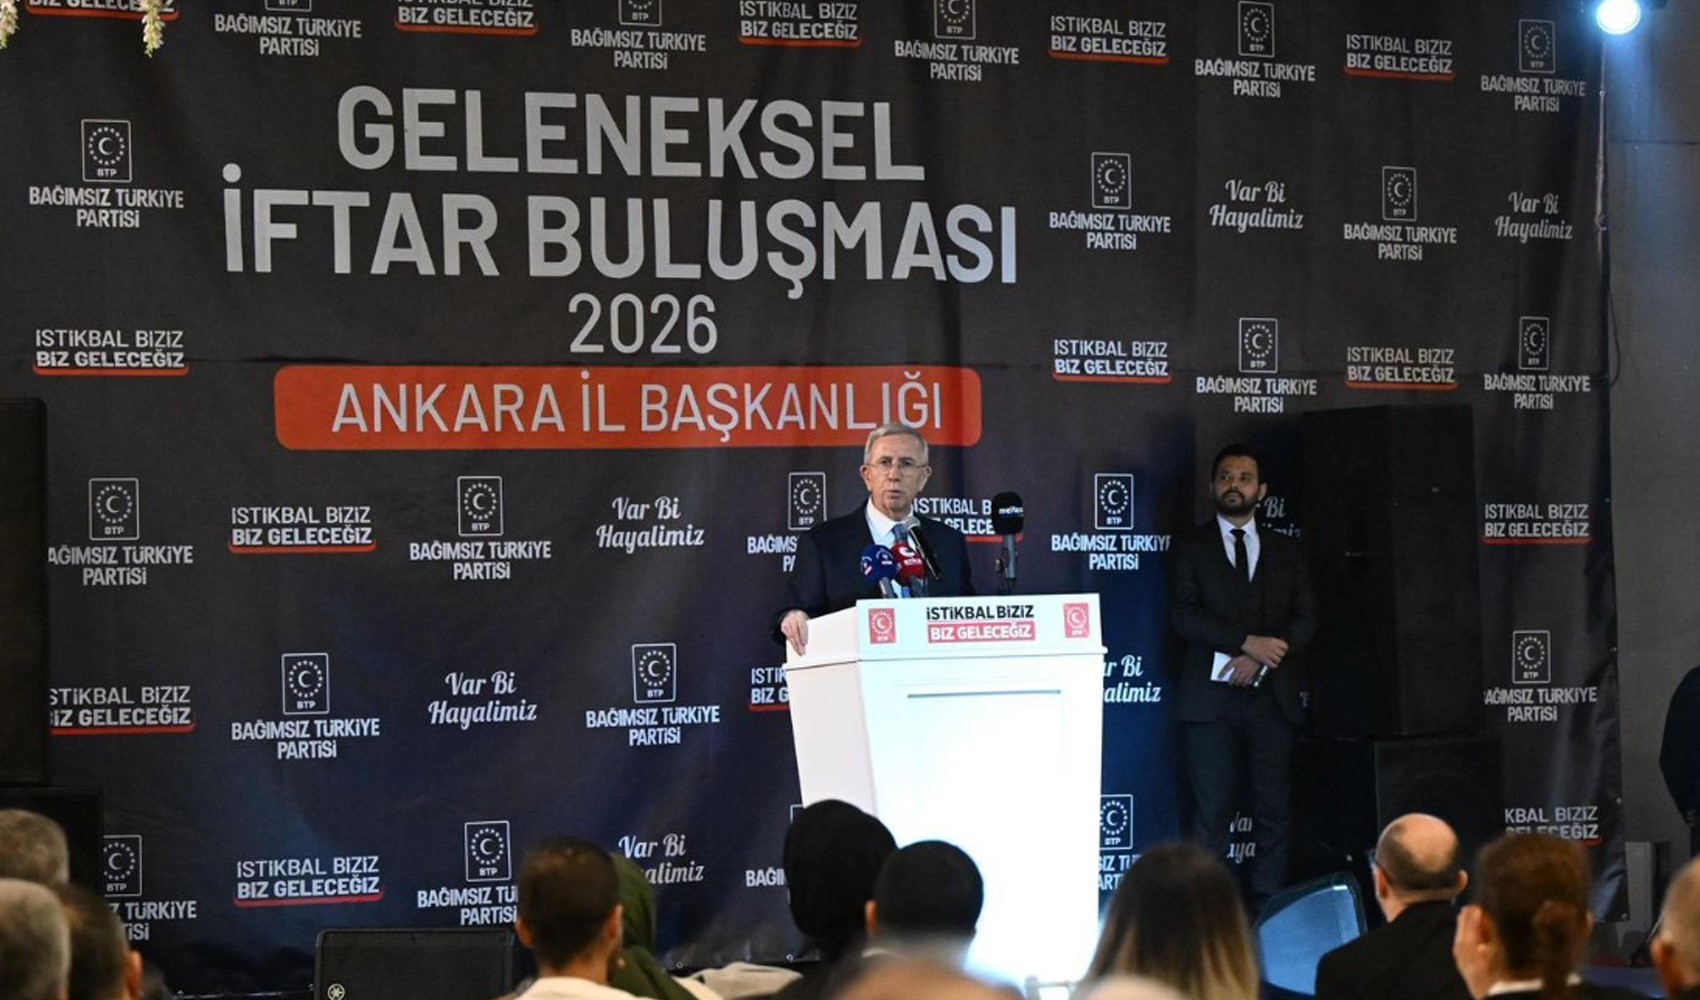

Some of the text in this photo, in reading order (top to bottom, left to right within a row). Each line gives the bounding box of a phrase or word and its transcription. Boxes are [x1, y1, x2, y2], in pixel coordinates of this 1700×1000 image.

[214, 13, 292, 34] BAĞIMSIZ
[571, 28, 644, 49] BAĞIMSIZ
[894, 39, 958, 61] BAĞIMSIZ
[1195, 57, 1260, 78] BAĞIMSIZ
[1481, 74, 1540, 93] BAĞIMSIZ
[338, 84, 925, 181] GELENEKSEL
[29, 184, 111, 207] BAĞIMSIZ
[1225, 179, 1286, 203] Var Bi
[1508, 191, 1559, 214] Var Bi
[1049, 210, 1115, 231] BAĞIMSIZ
[1210, 204, 1303, 233] Hayalimiz
[1495, 215, 1573, 243] Hayalimiz
[223, 163, 1017, 300] İFTAR BULUŞMASI
[1344, 222, 1403, 242] BAĞIMSIZ
[568, 292, 718, 354] 2026
[1196, 375, 1262, 394] BAĞIMSIZ
[1484, 371, 1535, 391] BAĞIMSIZ
[331, 369, 942, 443] ANKARA İL BAŞKANLIĞI
[612, 496, 681, 520] Var Bi
[596, 524, 704, 554] Hayalimiz
[747, 534, 799, 554] BAĞIMS
[1051, 532, 1117, 551] BAĞIMSIZ
[409, 540, 484, 561] BAĞIMSIZ
[927, 605, 1034, 620] İSTİKBAL BİZİZ
[1121, 655, 1144, 677] Bi
[445, 670, 516, 696] Var Bi
[1484, 687, 1534, 705] AĞIMSIZ
[428, 699, 537, 730] Hayalimiz
[586, 707, 658, 728] BAĞIMSIZ
[231, 720, 310, 741] BAĞIMSIZ
[618, 833, 686, 860] Var Bi
[641, 861, 705, 884] alimiz
[417, 886, 493, 908] BAĞIMSIZ
